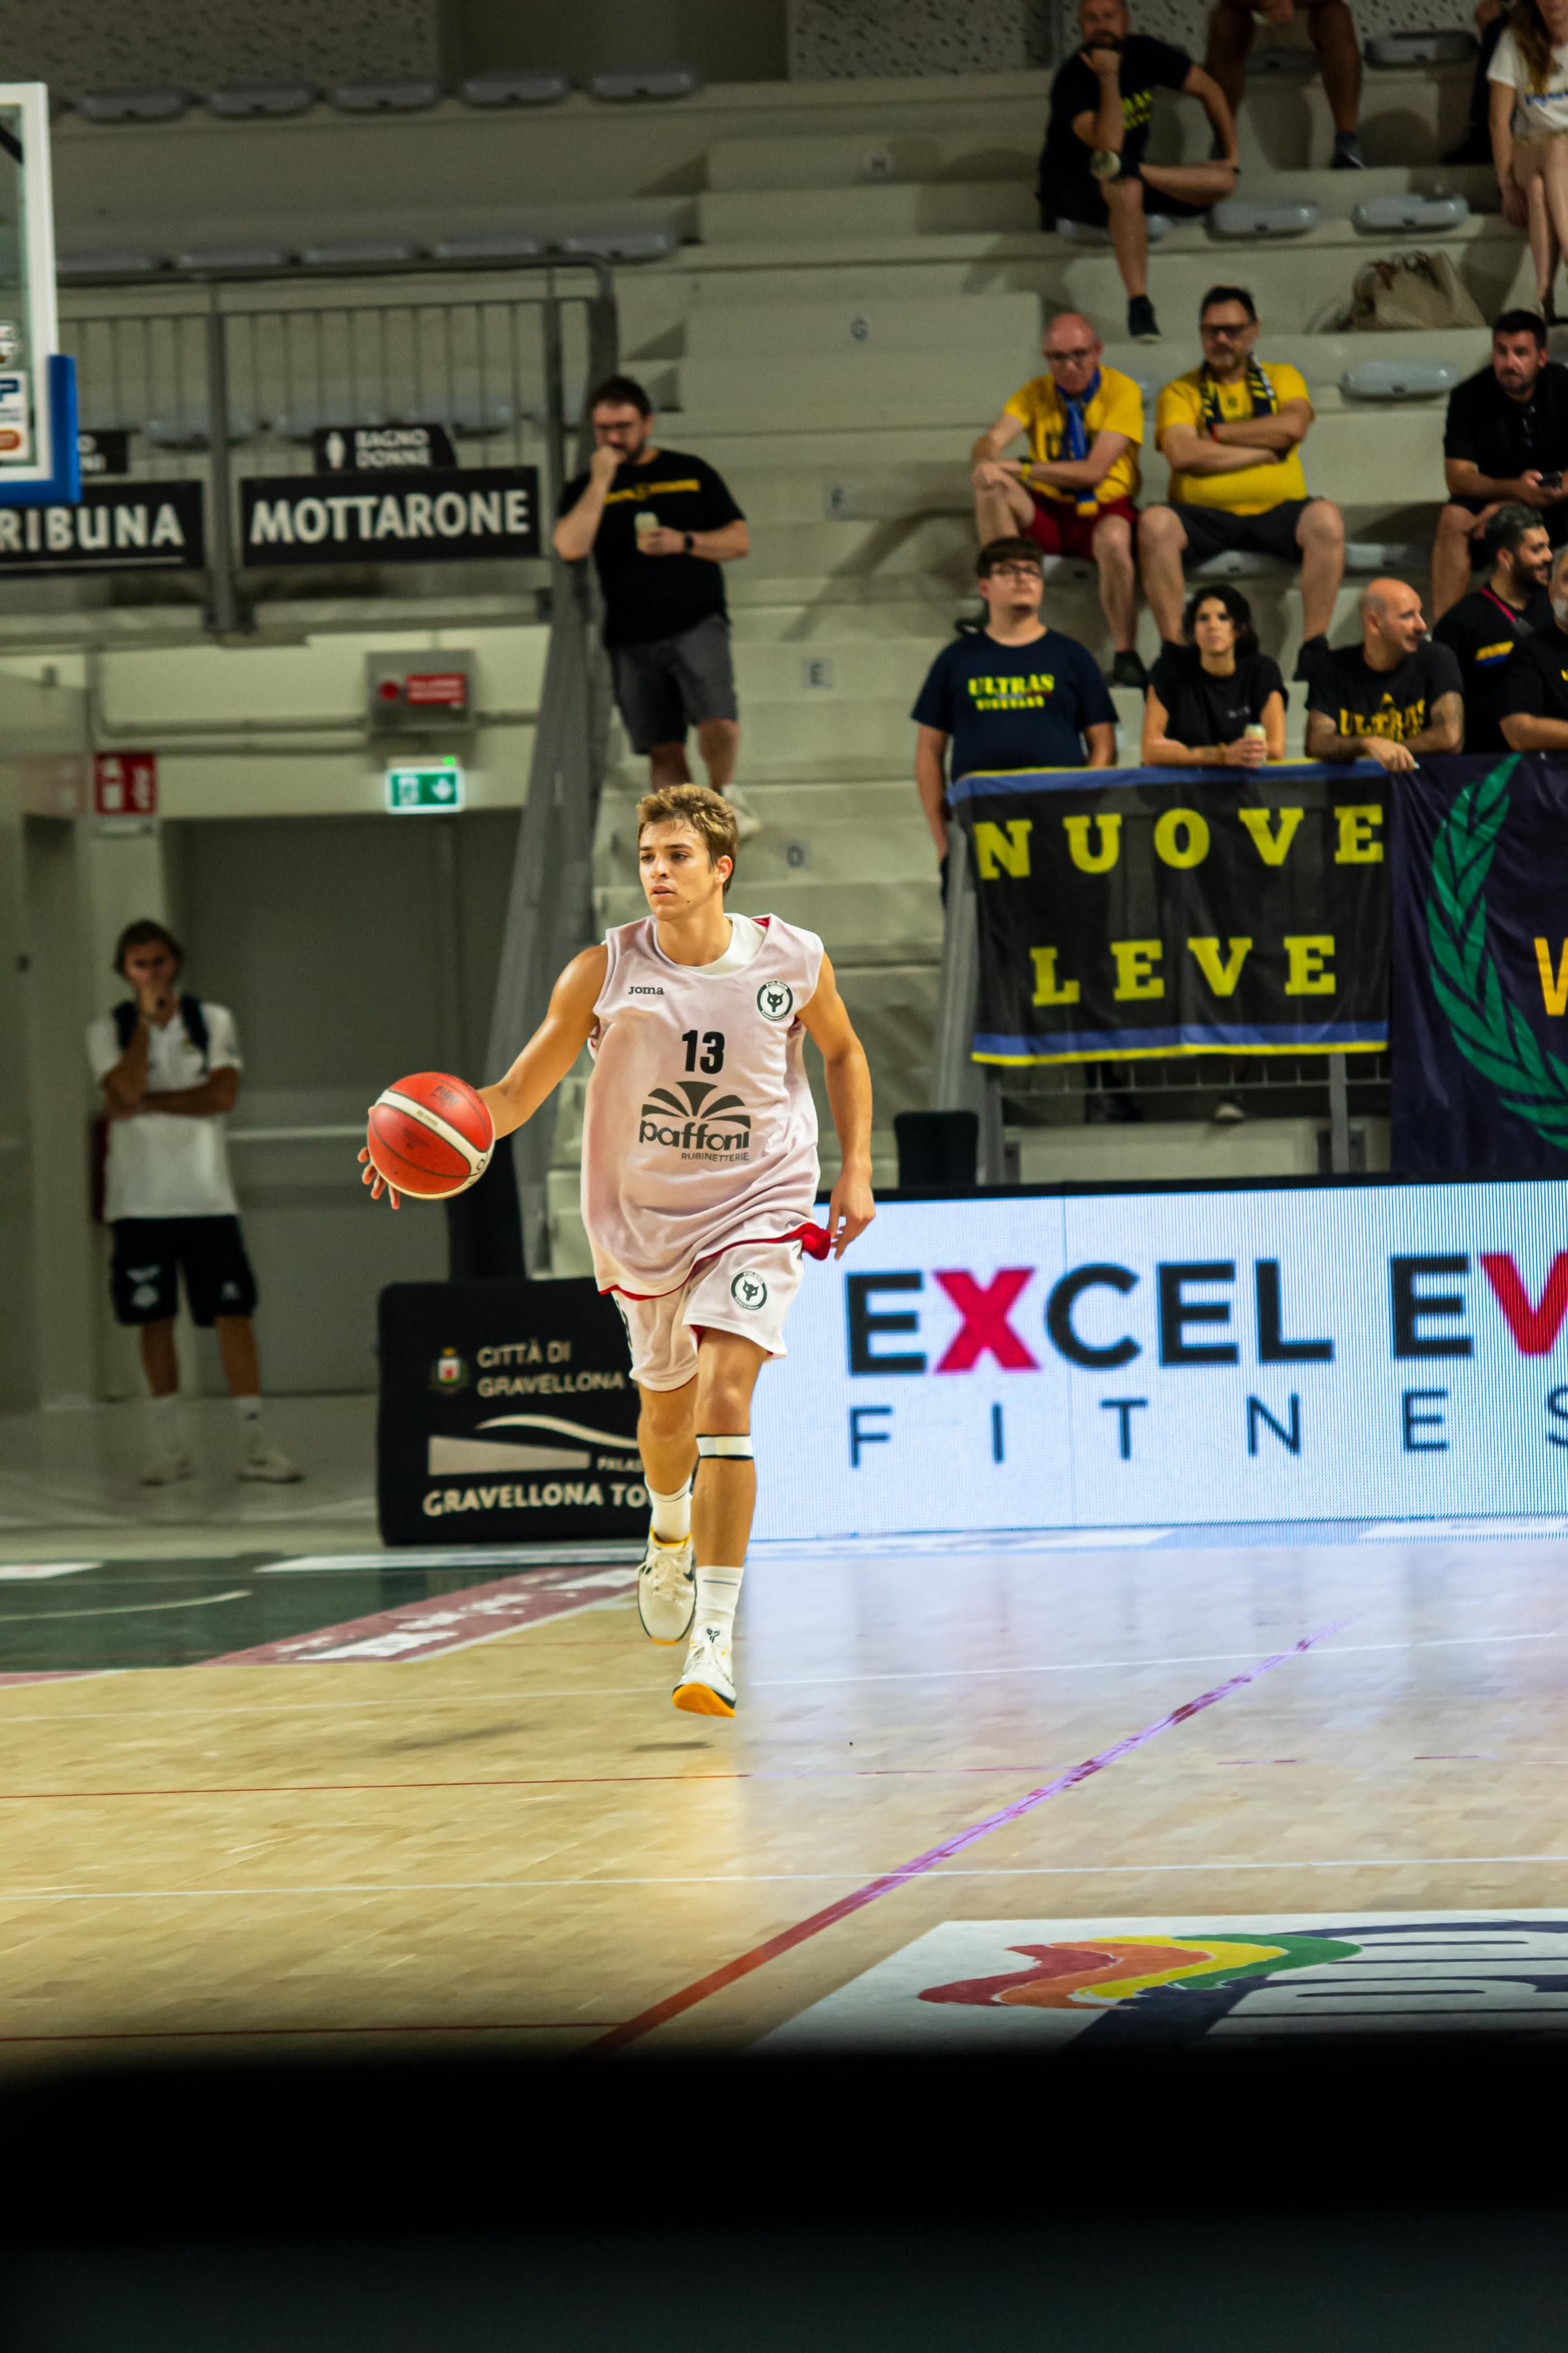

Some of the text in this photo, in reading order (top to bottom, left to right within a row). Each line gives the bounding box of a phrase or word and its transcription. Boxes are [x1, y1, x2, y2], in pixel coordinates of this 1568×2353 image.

[0, 502, 185, 552] RIBUNA
[249, 489, 530, 545] MOTTARONE
[967, 673, 1055, 696] ULTRAS
[973, 804, 1384, 880] NUOVE
[1029, 934, 1336, 1007] LEVE
[682, 1029, 725, 1075] 13
[639, 1120, 750, 1151] paffoni
[681, 1151, 750, 1162] RUBINETTERIE
[845, 1259, 1335, 1377] EXCEL
[477, 1337, 572, 1368] CITTÀ DI
[477, 1370, 625, 1398] GRAVELLONA
[422, 1482, 651, 1518] GRAVELLONA TO
